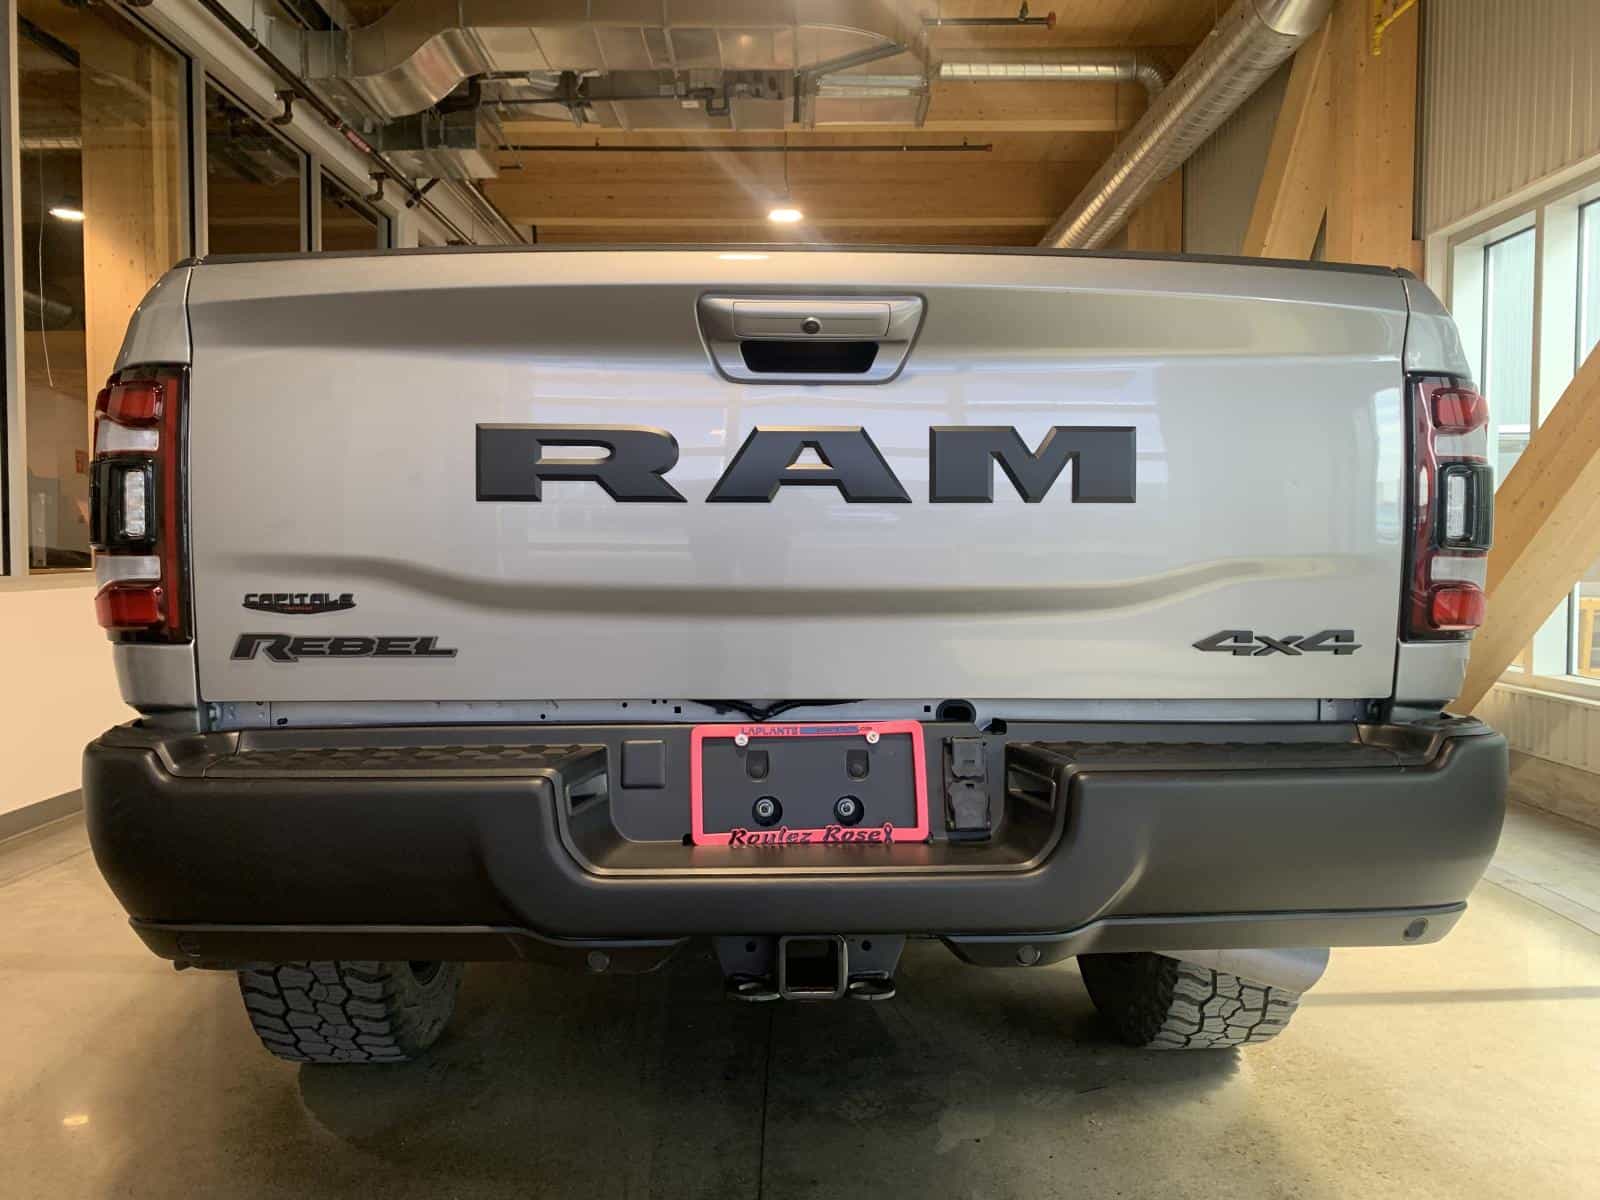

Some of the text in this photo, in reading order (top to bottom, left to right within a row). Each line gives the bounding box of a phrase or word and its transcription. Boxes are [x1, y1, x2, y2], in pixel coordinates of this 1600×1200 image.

[476, 422, 1137, 504] RAM
[231, 633, 457, 662] REBEL
[1192, 629, 1362, 656] 4x4
[728, 826, 881, 845] Roulez Rose
